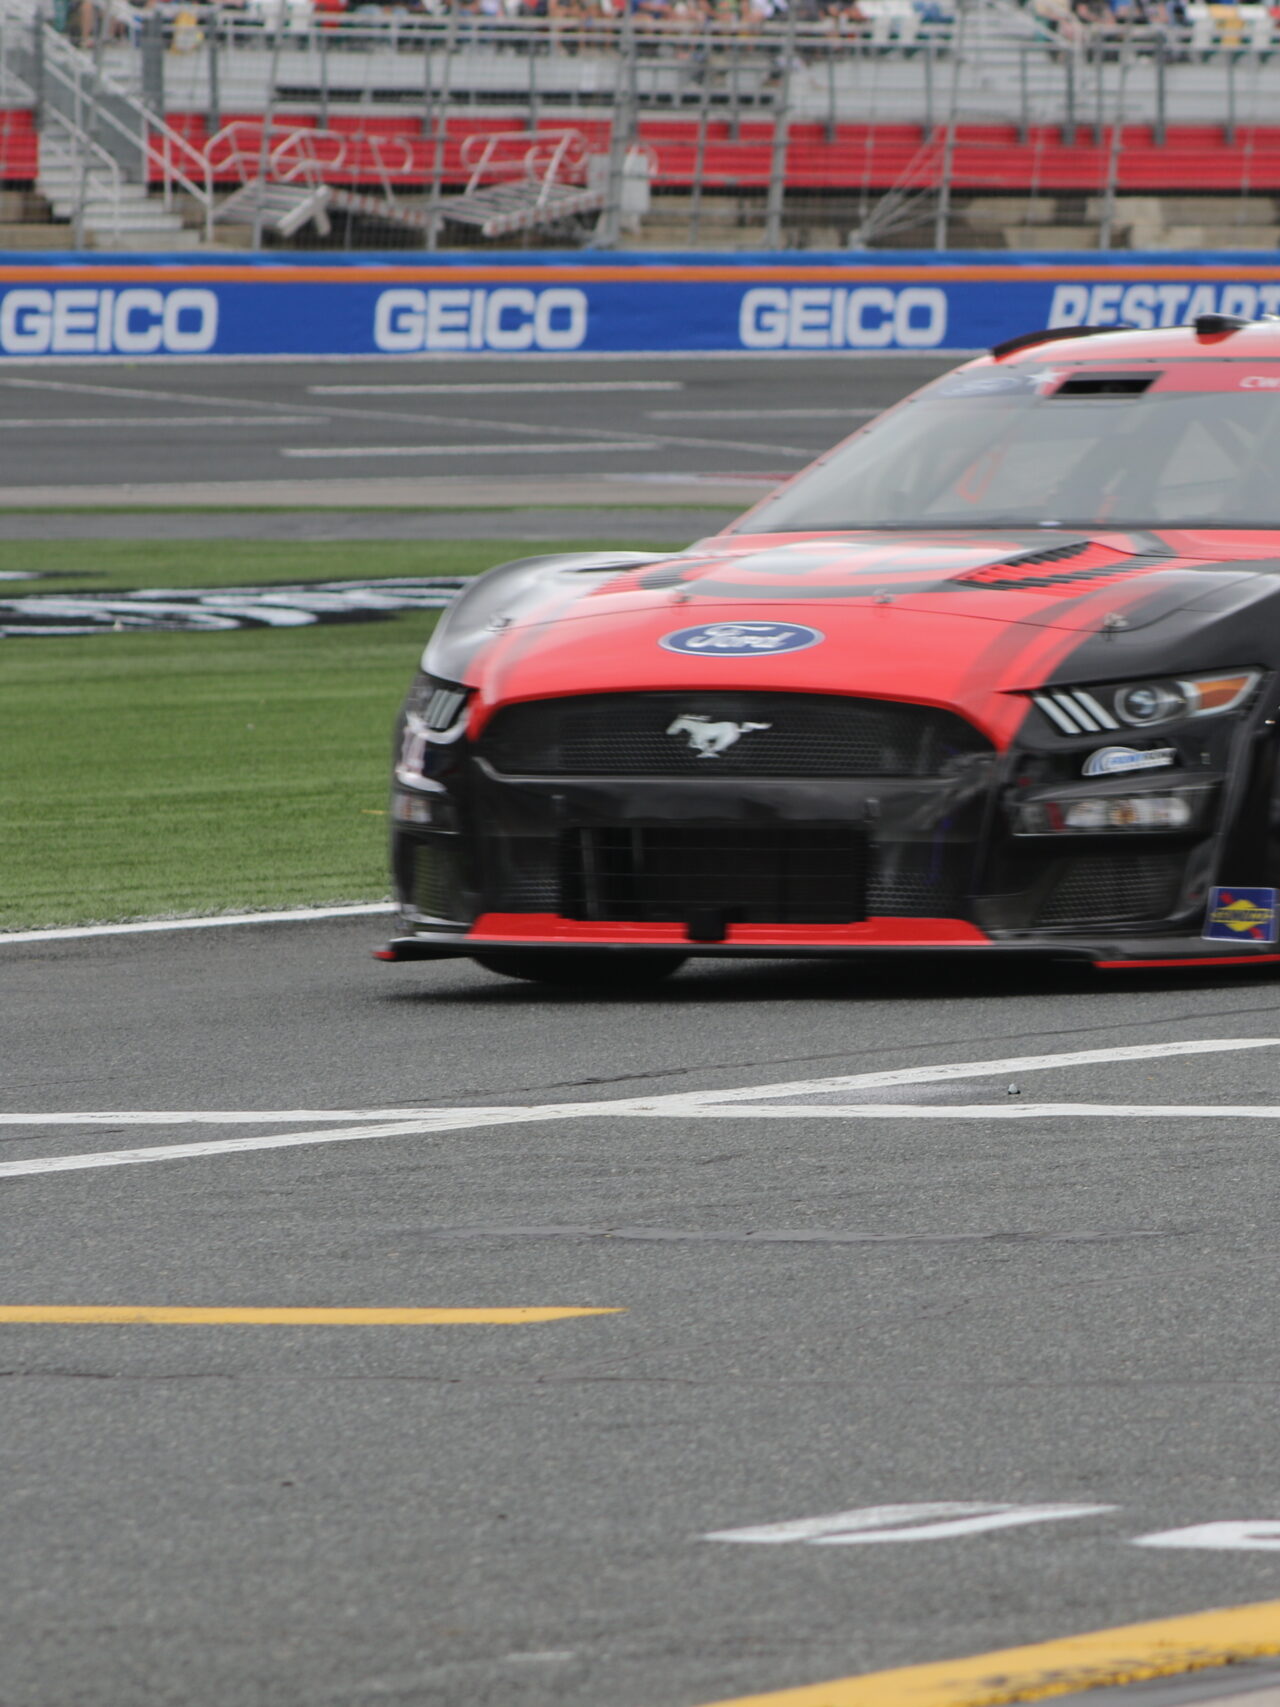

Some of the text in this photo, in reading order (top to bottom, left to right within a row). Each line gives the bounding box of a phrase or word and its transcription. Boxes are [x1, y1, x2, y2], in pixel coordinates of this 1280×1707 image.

[1, 288, 219, 353] GEICO
[374, 287, 588, 351] GEICO
[739, 287, 948, 348] GEICO
[685, 624, 797, 649] Ford
